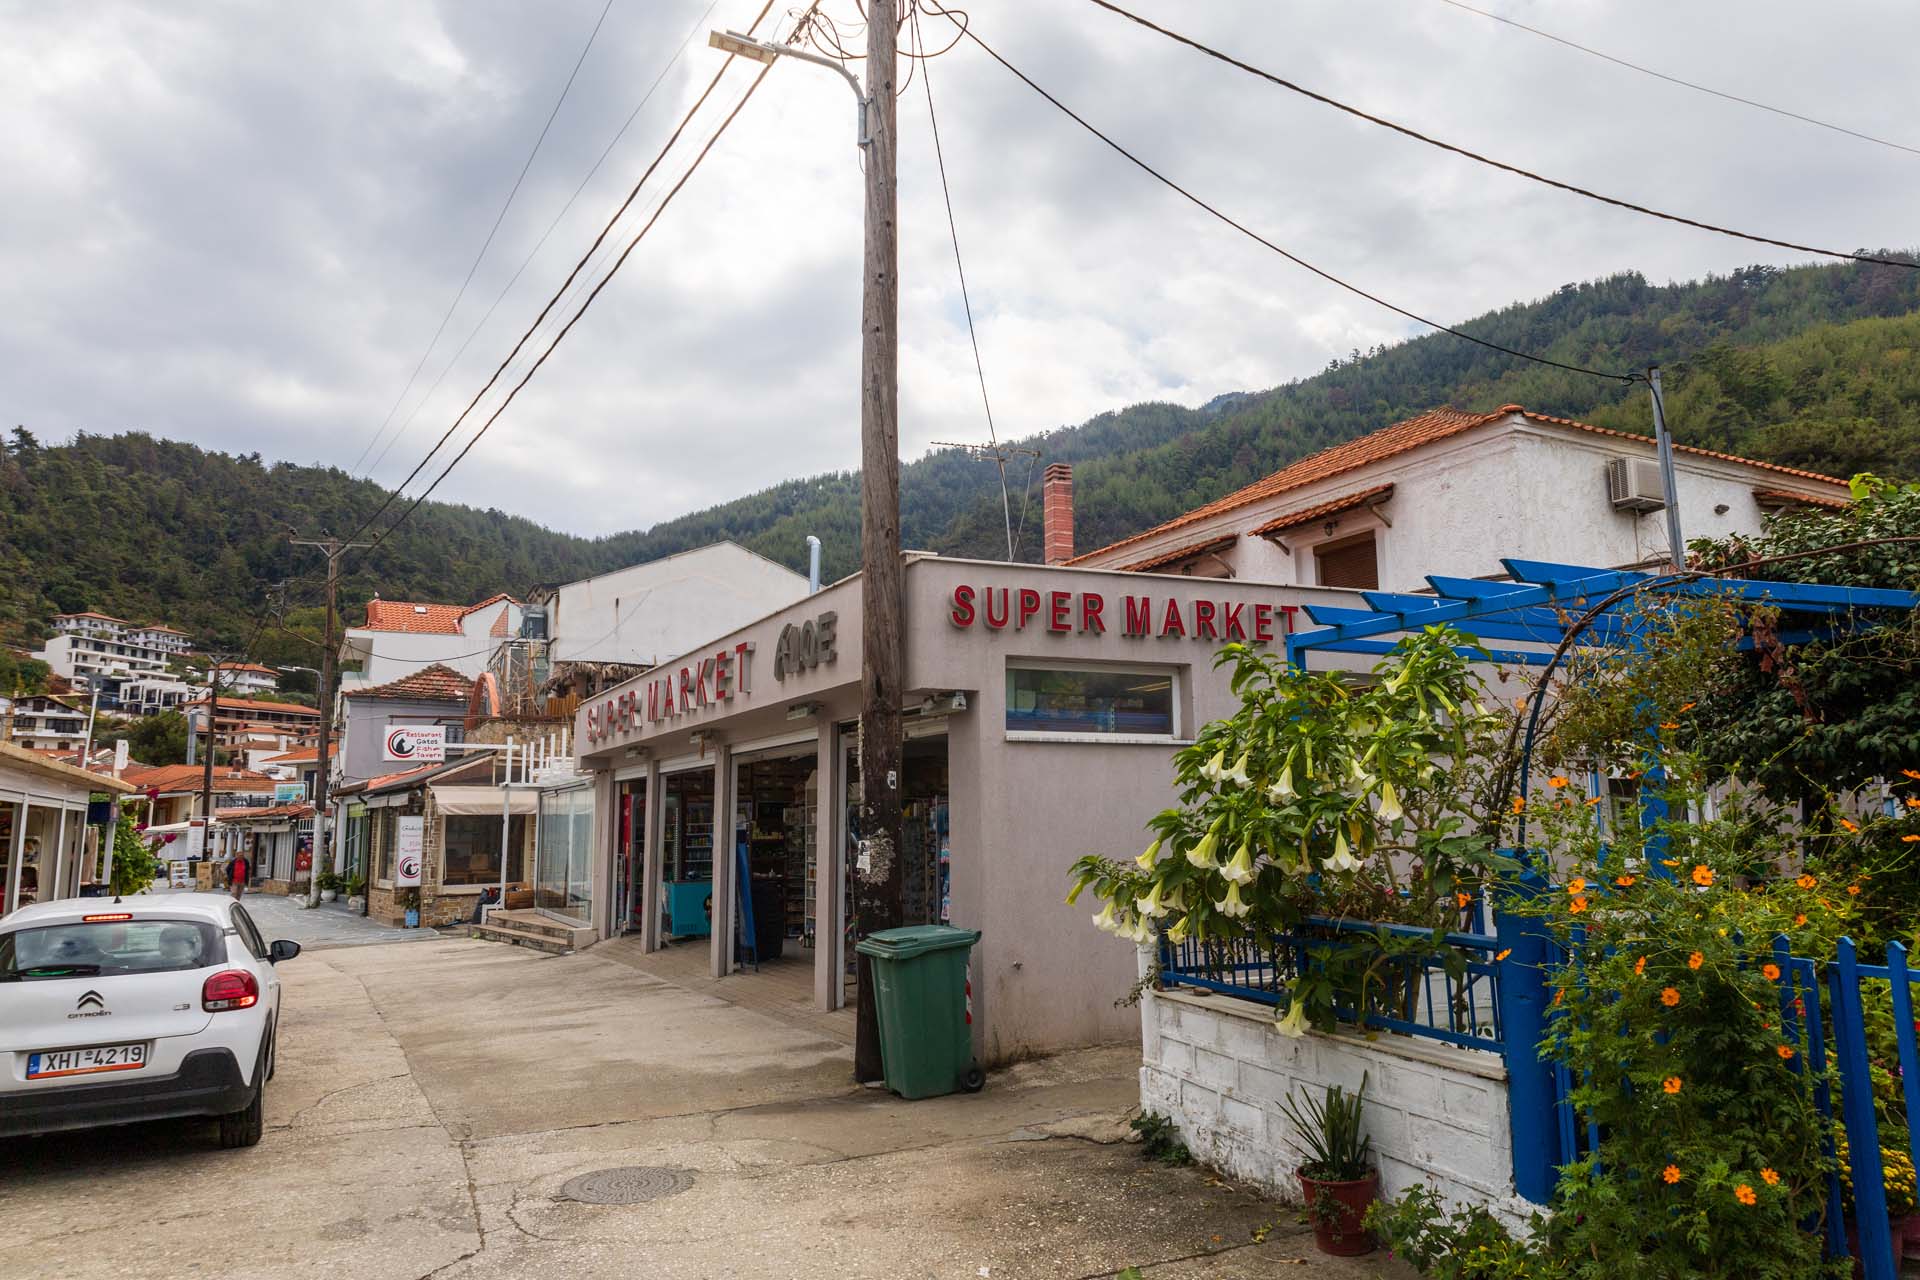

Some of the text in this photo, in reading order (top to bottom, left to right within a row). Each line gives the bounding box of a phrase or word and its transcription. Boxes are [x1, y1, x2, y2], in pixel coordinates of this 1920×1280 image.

[951, 585, 1300, 642] SUPER MARKET
[587, 689, 643, 744] SUPER
[648, 641, 756, 722] MARKET
